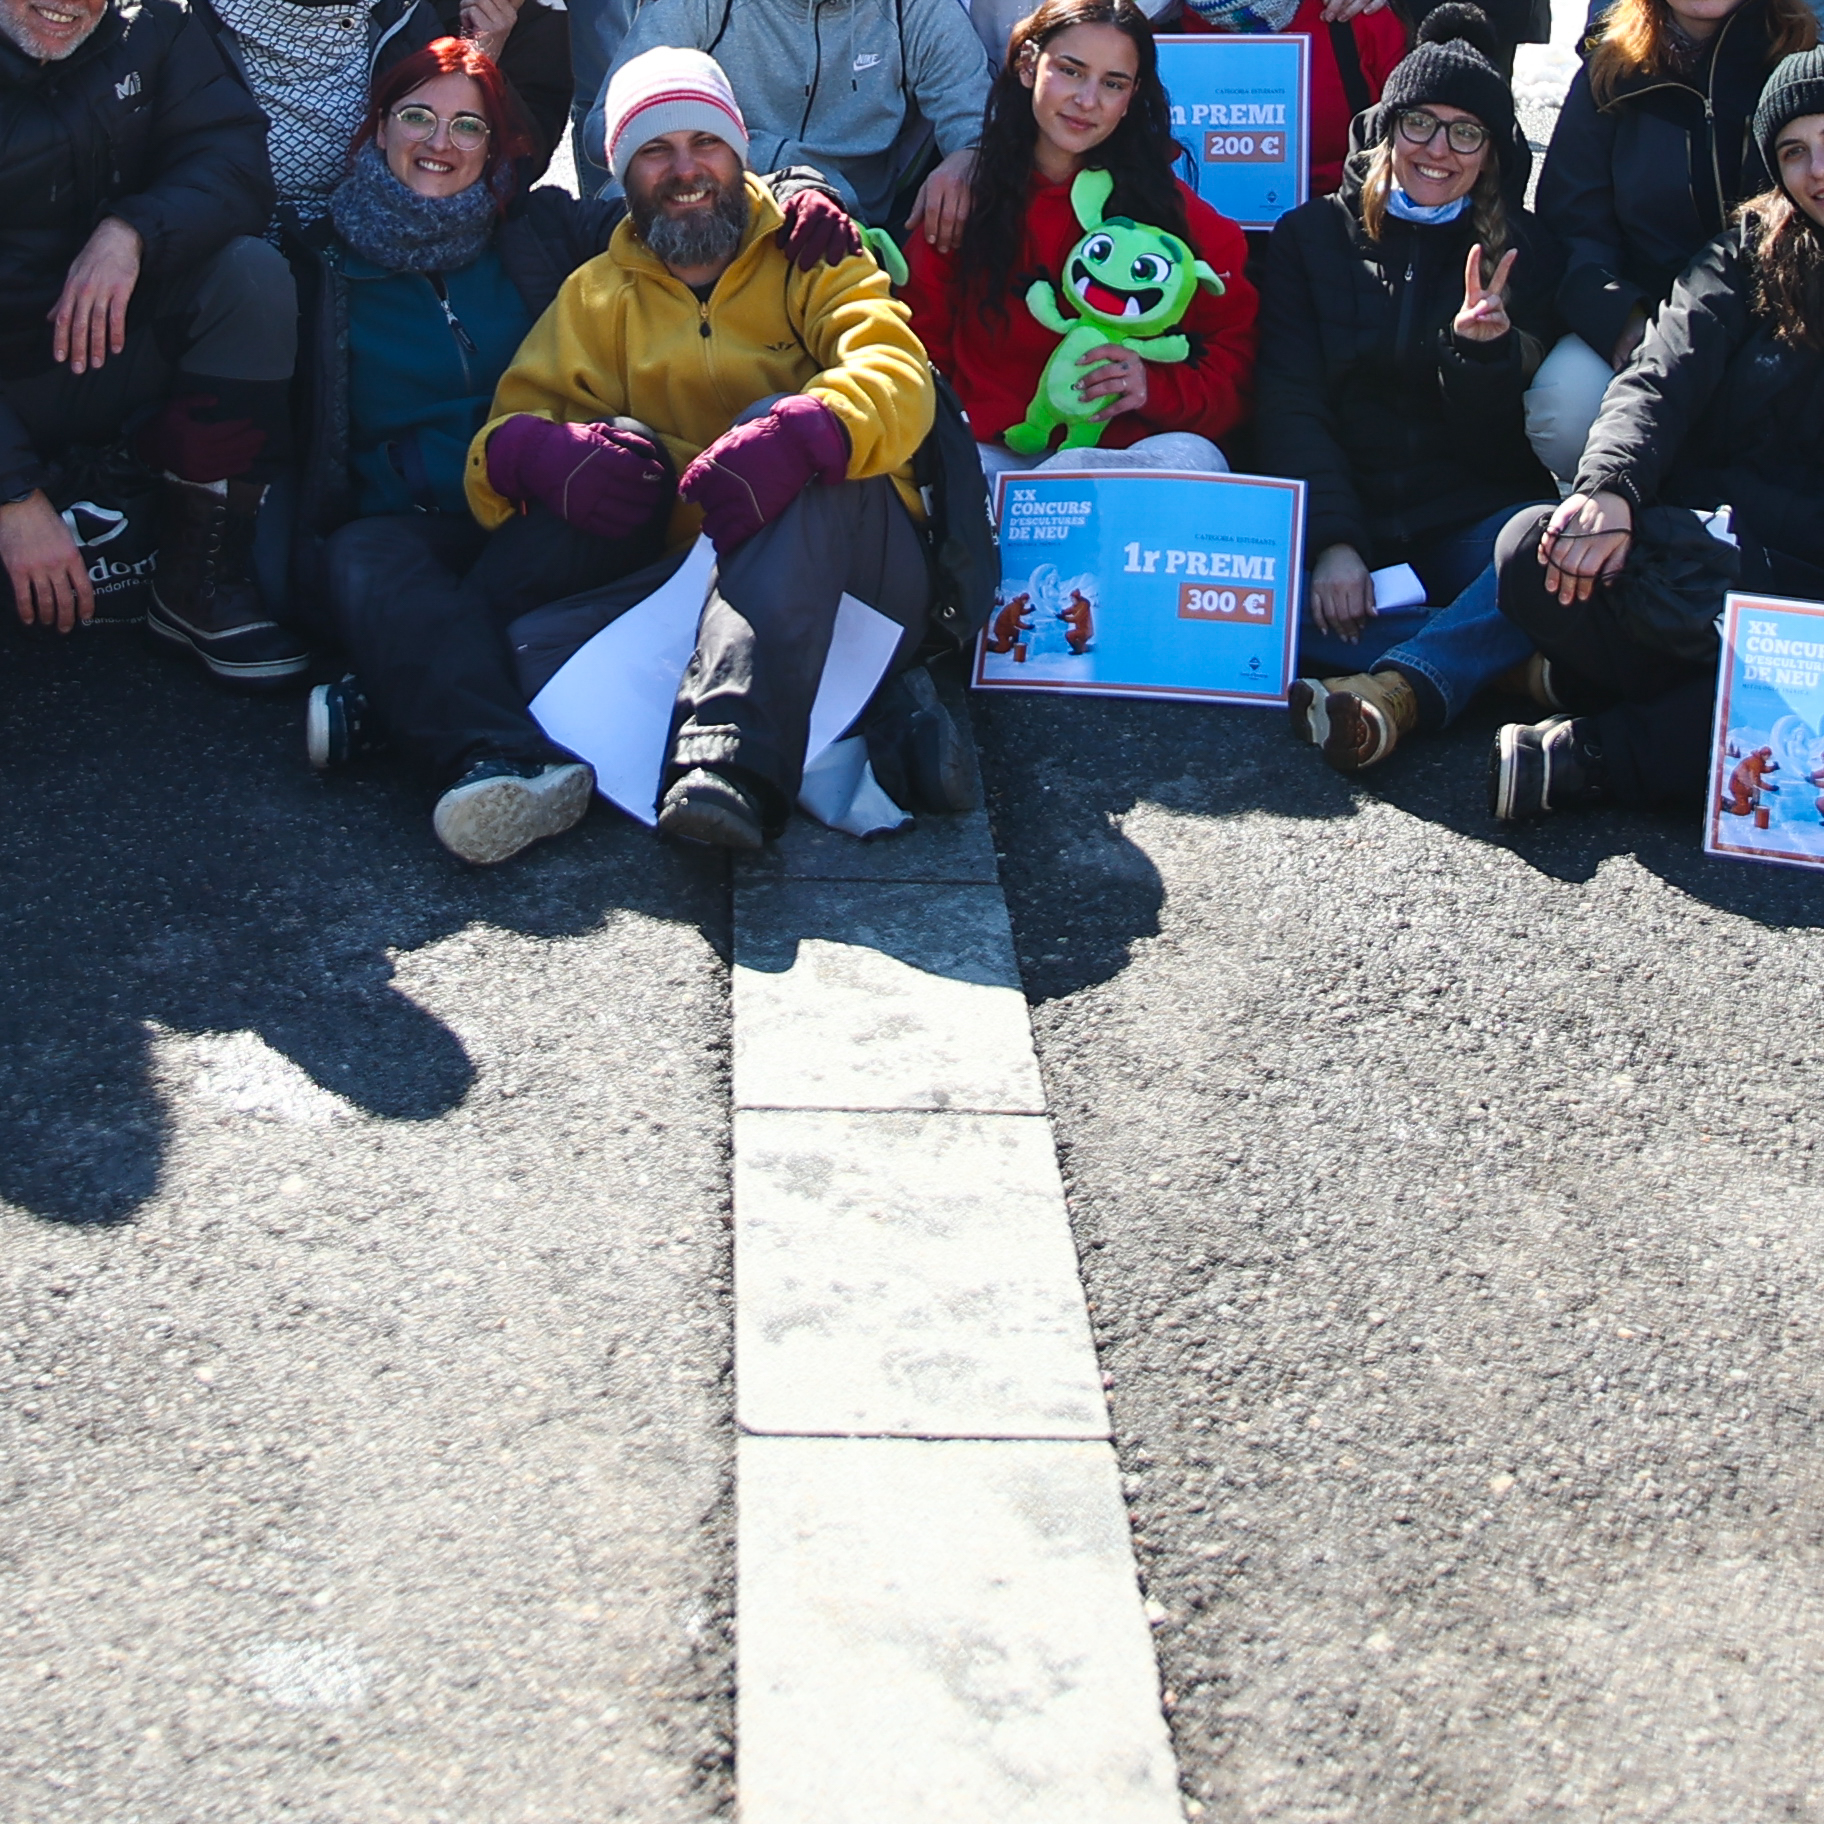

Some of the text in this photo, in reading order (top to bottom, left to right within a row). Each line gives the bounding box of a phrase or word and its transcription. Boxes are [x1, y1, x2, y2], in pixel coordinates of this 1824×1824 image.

[1191, 104, 1286, 125] PREMI
[1210, 136, 1279, 155] 200 €
[1012, 489, 1037, 502] XX
[1011, 501, 1092, 516] CONCURS
[1009, 517, 1086, 526] D'ESCULTURES
[1008, 526, 1069, 540] DE NEU
[1123, 541, 1276, 581] 1r PREMI
[1186, 588, 1266, 615] 300 €
[1747, 620, 1778, 637] XX
[1743, 664, 1821, 687] DE NEU
